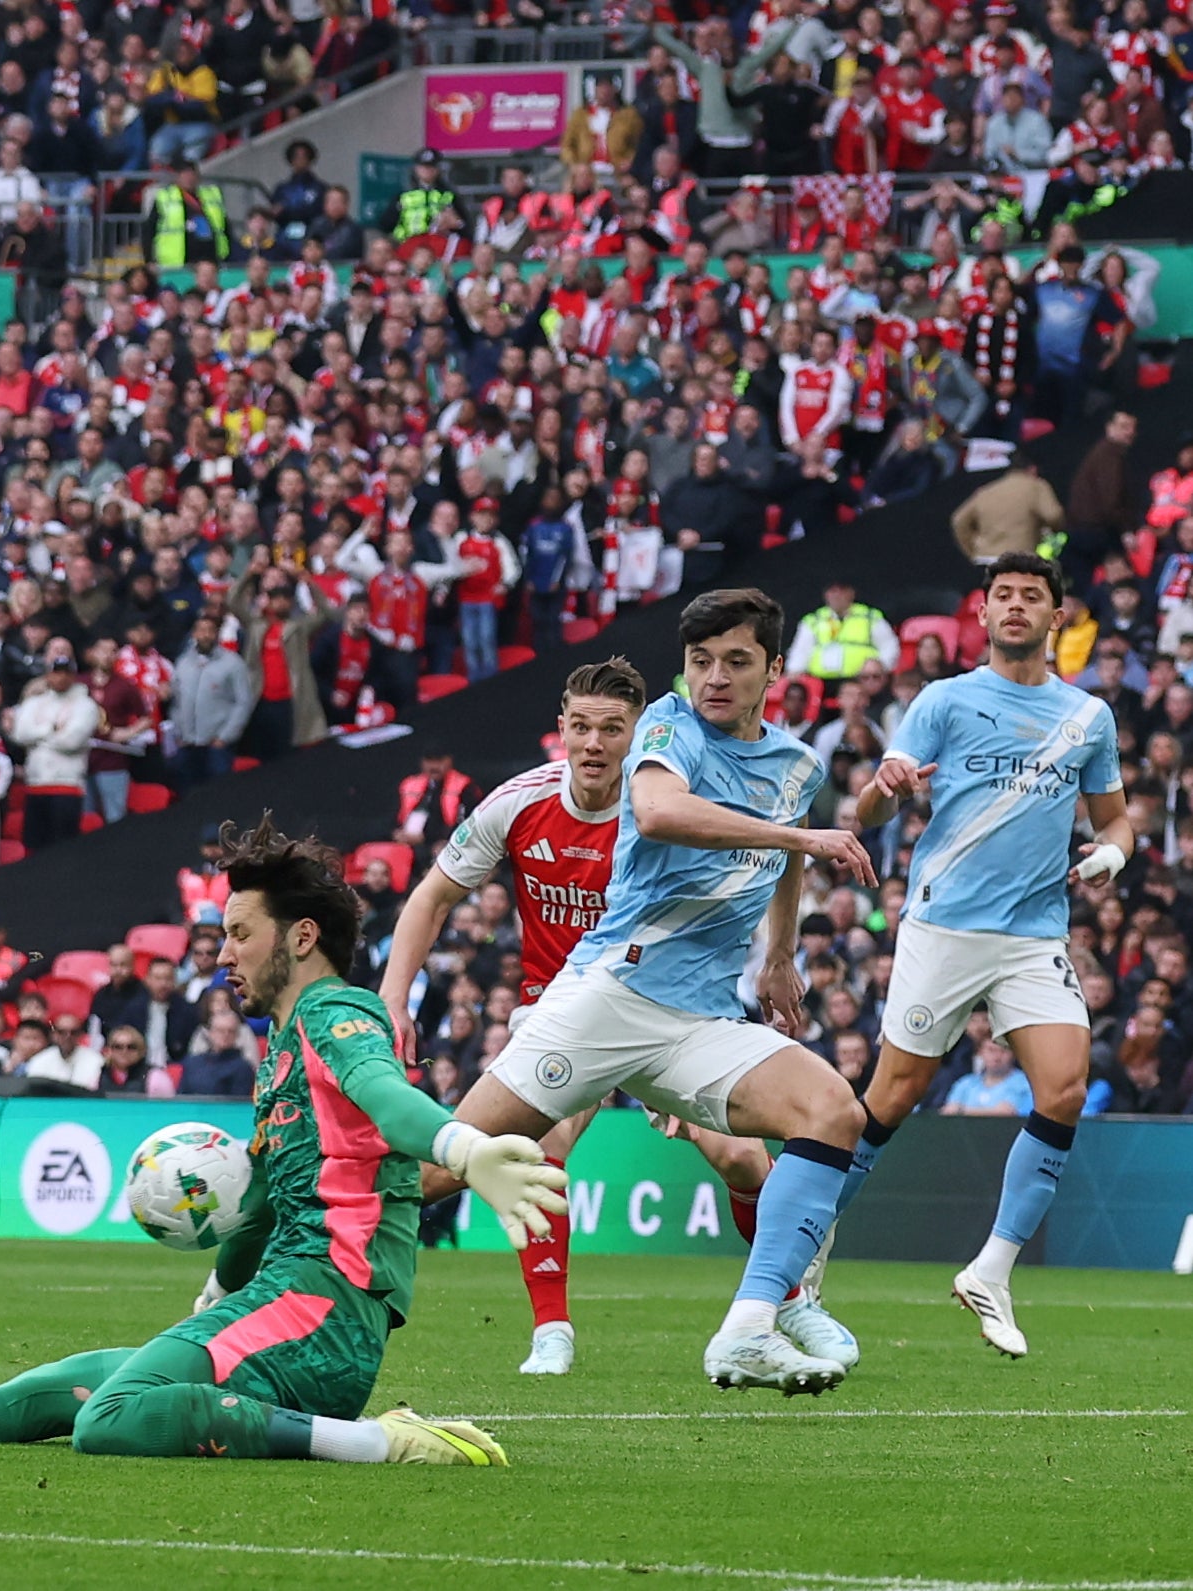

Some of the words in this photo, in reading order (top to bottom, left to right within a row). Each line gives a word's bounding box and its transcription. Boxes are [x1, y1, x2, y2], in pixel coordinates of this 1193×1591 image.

[965, 754, 1078, 785] ETIHAD
[989, 778, 1061, 800] AIRWAYS
[523, 872, 607, 909] Emira
[542, 903, 567, 925] FLY
[40, 1150, 91, 1182] EA
